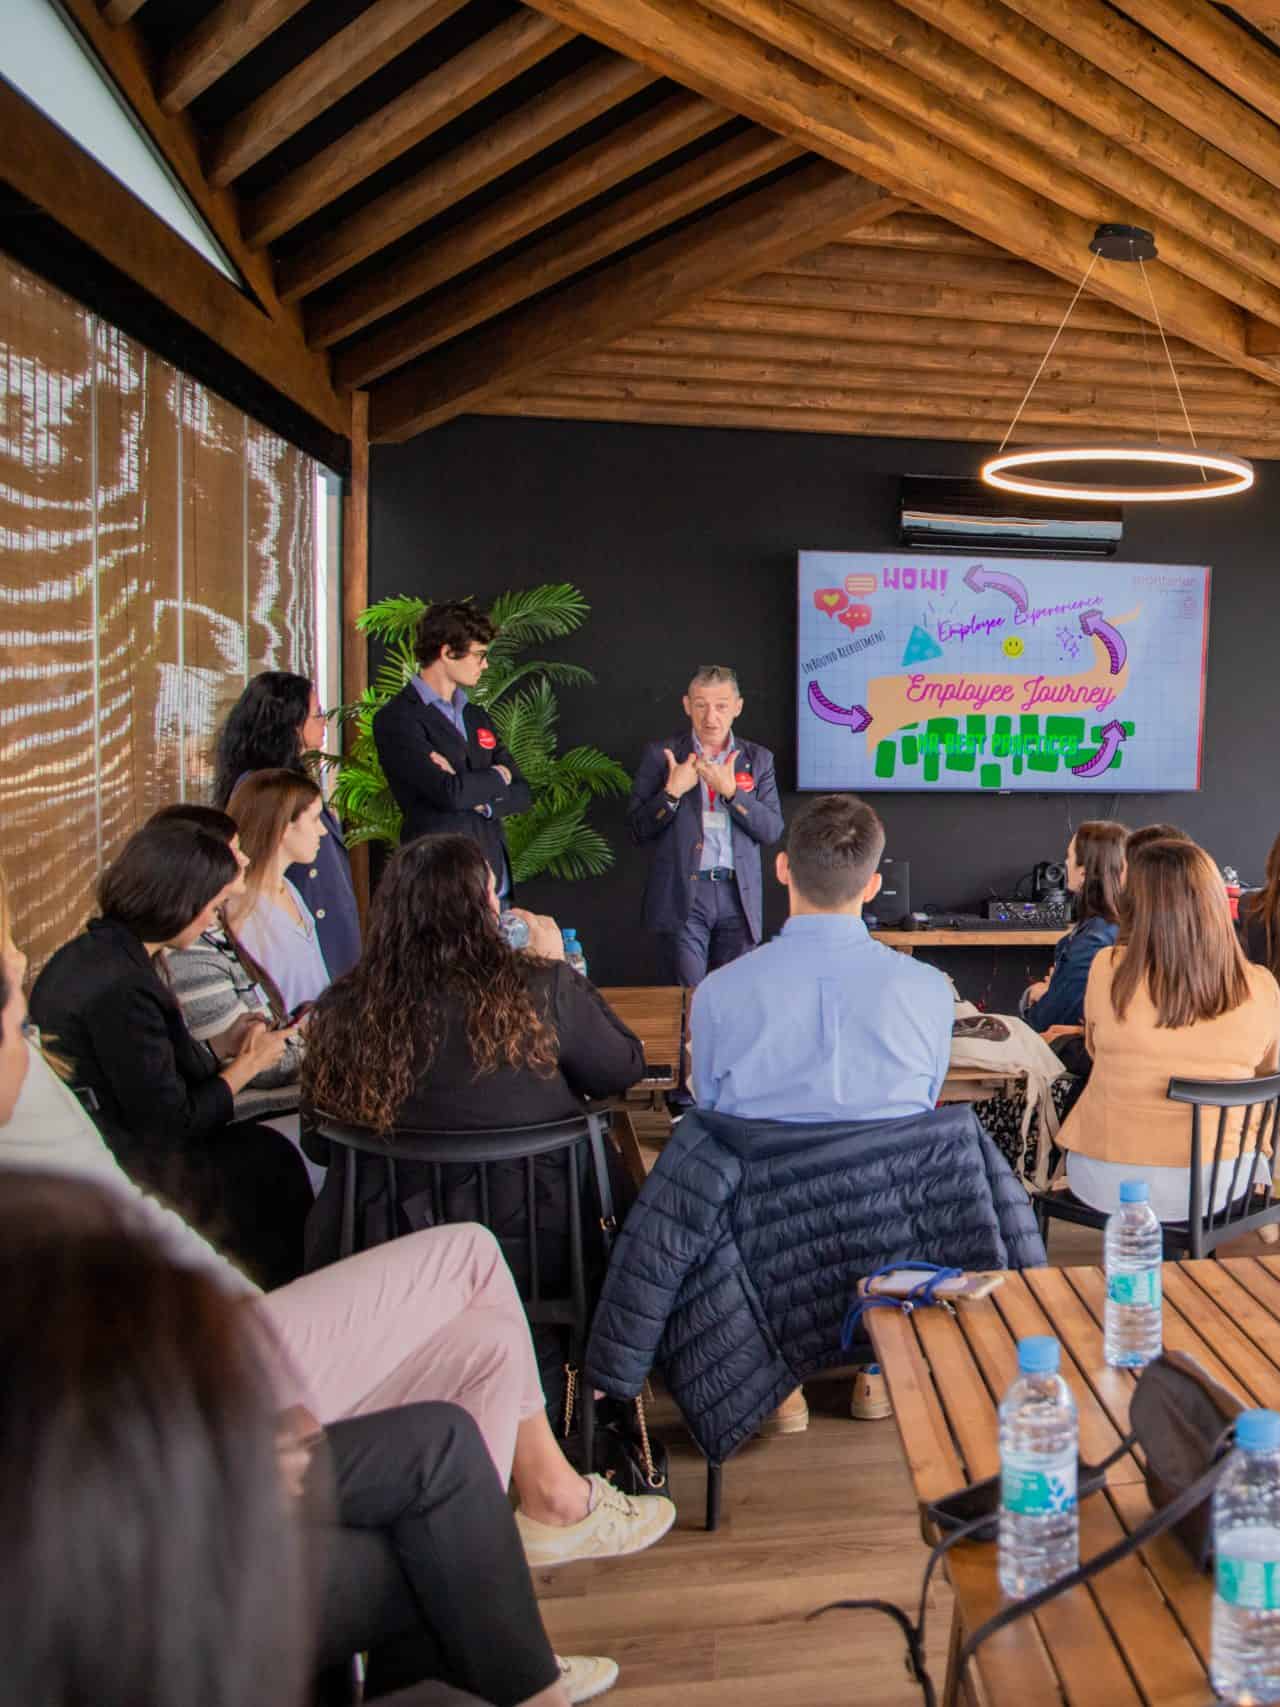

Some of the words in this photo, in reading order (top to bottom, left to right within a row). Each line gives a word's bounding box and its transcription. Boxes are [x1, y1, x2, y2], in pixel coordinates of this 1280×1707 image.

[882, 567, 948, 597] WOW!
[937, 614, 1005, 642] Employee
[906, 673, 1014, 711] Employee
[1021, 675, 1116, 712] Journey
